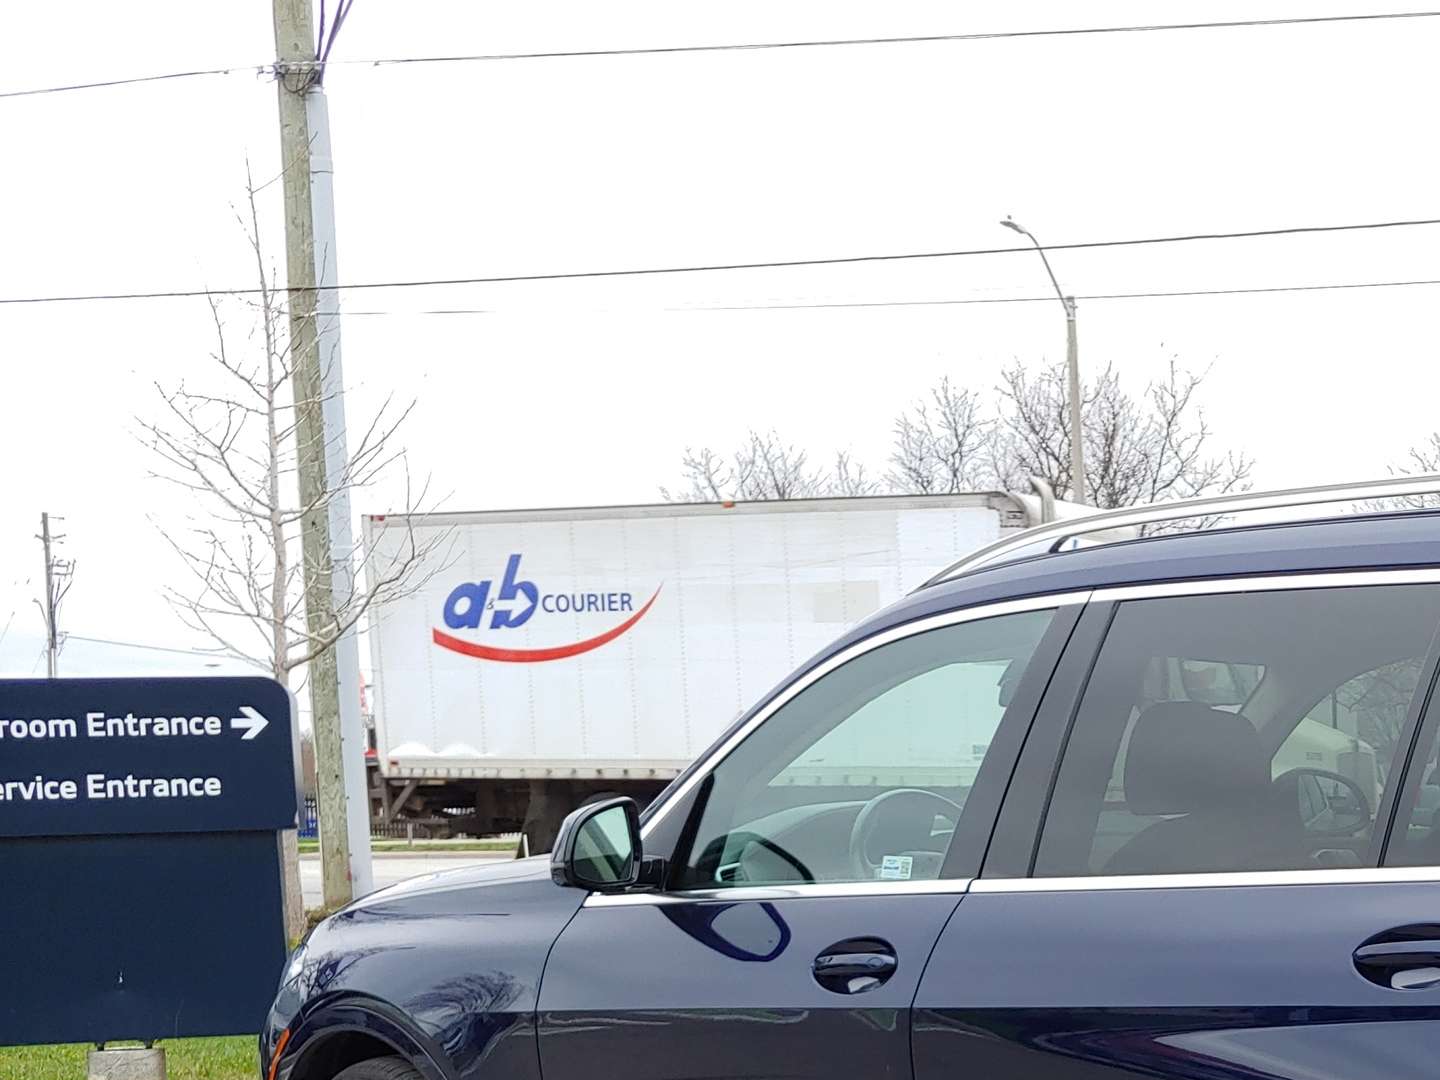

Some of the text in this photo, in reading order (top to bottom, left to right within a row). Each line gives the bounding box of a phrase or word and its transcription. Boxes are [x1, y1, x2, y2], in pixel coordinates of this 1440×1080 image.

[542, 593, 633, 613] COURIER
[87, 712, 221, 737] Entrance
[0, 774, 221, 800] rvice Entrance
